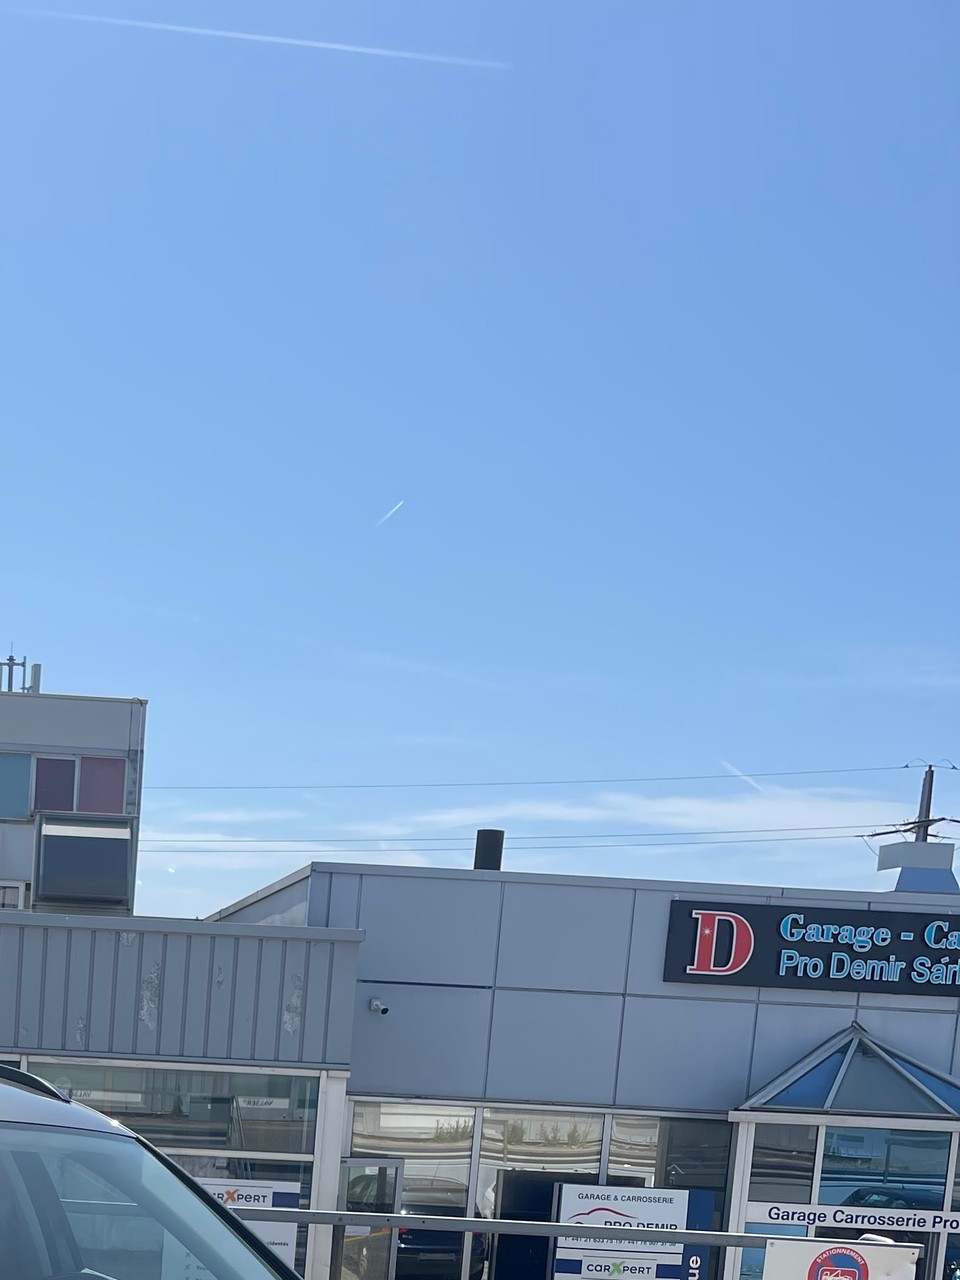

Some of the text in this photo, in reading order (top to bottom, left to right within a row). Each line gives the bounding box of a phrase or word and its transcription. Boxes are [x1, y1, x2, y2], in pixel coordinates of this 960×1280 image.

[780, 913, 891, 952] Garage
[779, 949, 824, 979] Pro
[829, 952, 907, 982] Demir
[577, 1192, 611, 1201] GARAGE
[620, 1195, 675, 1204] CARROSSERIE
[768, 1206, 960, 1230] Garage Carrosserie Pro
[816, 1248, 865, 1265] STATIONNEMENT
